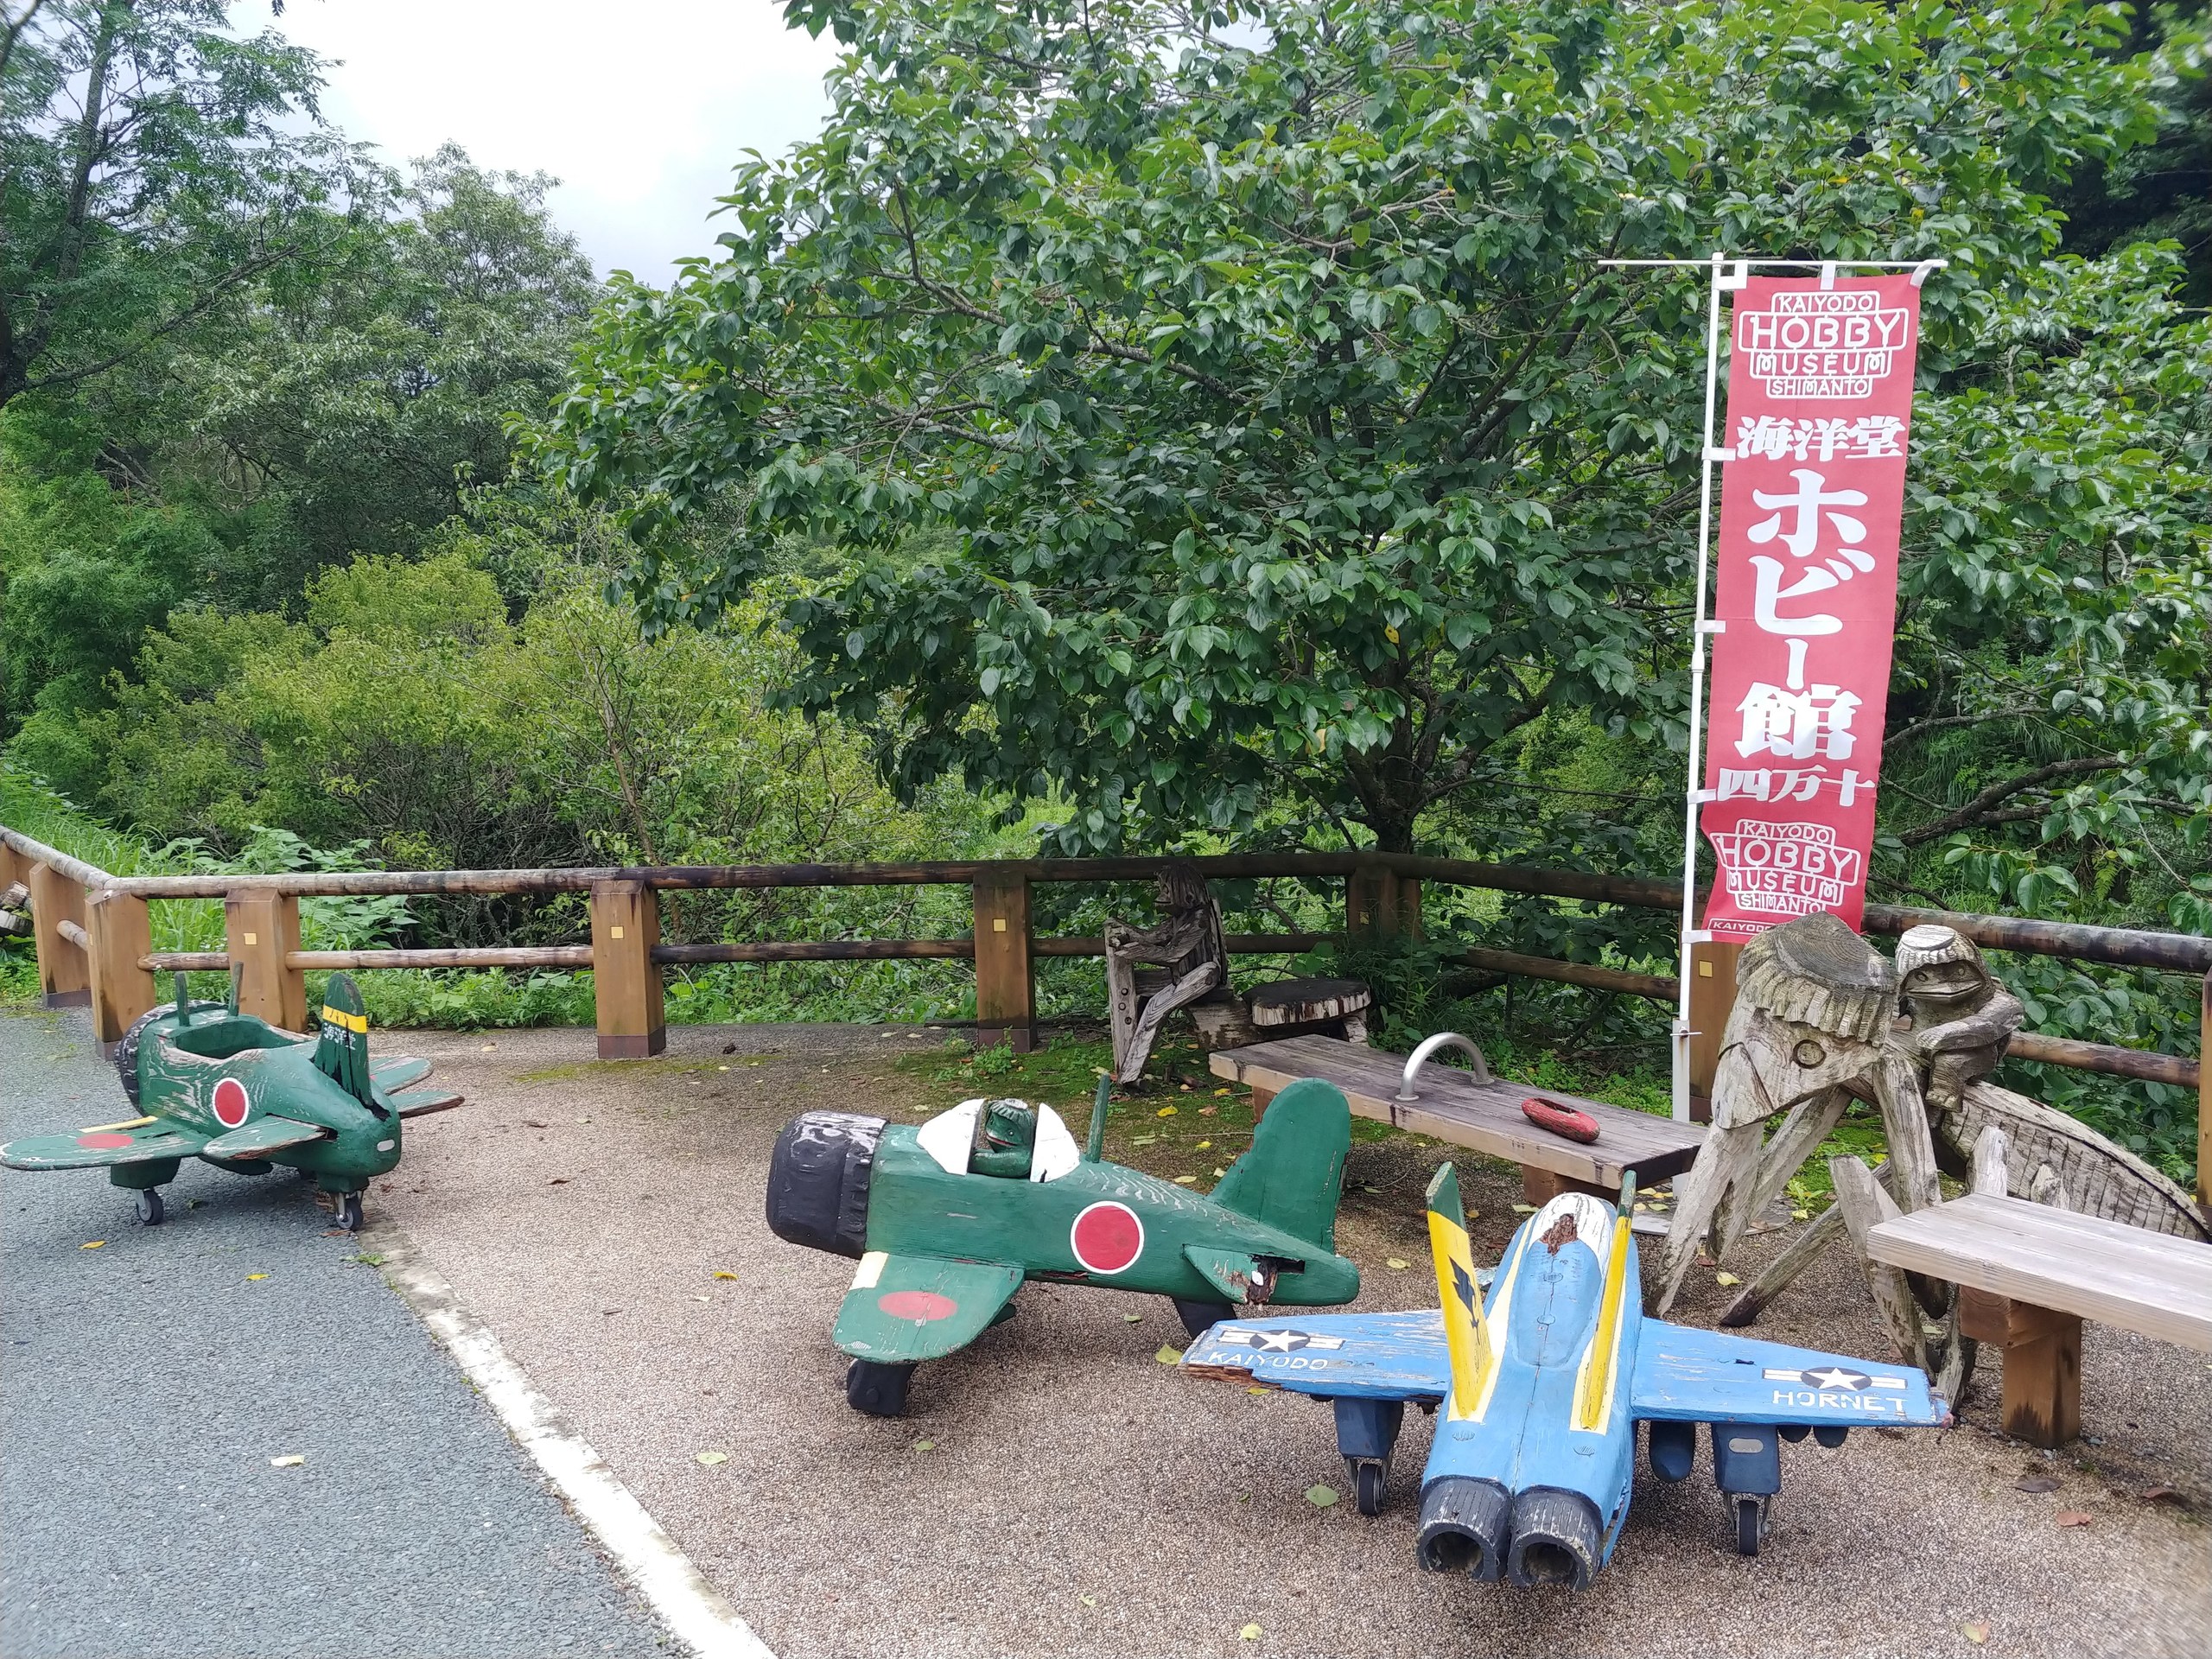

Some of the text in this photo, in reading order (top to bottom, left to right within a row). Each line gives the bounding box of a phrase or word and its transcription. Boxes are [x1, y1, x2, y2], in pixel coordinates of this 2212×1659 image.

[1778, 295, 1873, 313] KAIYODO
[1750, 311, 1900, 349] HOBBY
[1756, 351, 1885, 376] MUSEUM
[1771, 378, 1868, 395] SHIMANTO
[1737, 415, 1905, 461] 海洋堂
[1734, 468, 1875, 760] ホビー館
[1717, 765, 1875, 807] 四万十
[1744, 821, 1829, 843] KAIYODO
[1716, 836, 1853, 880] HOBBY
[1729, 869, 1838, 903] MUSEUM
[1740, 893, 1825, 912] SHIMANTO
[1772, 1389, 1908, 1417] HORNET
